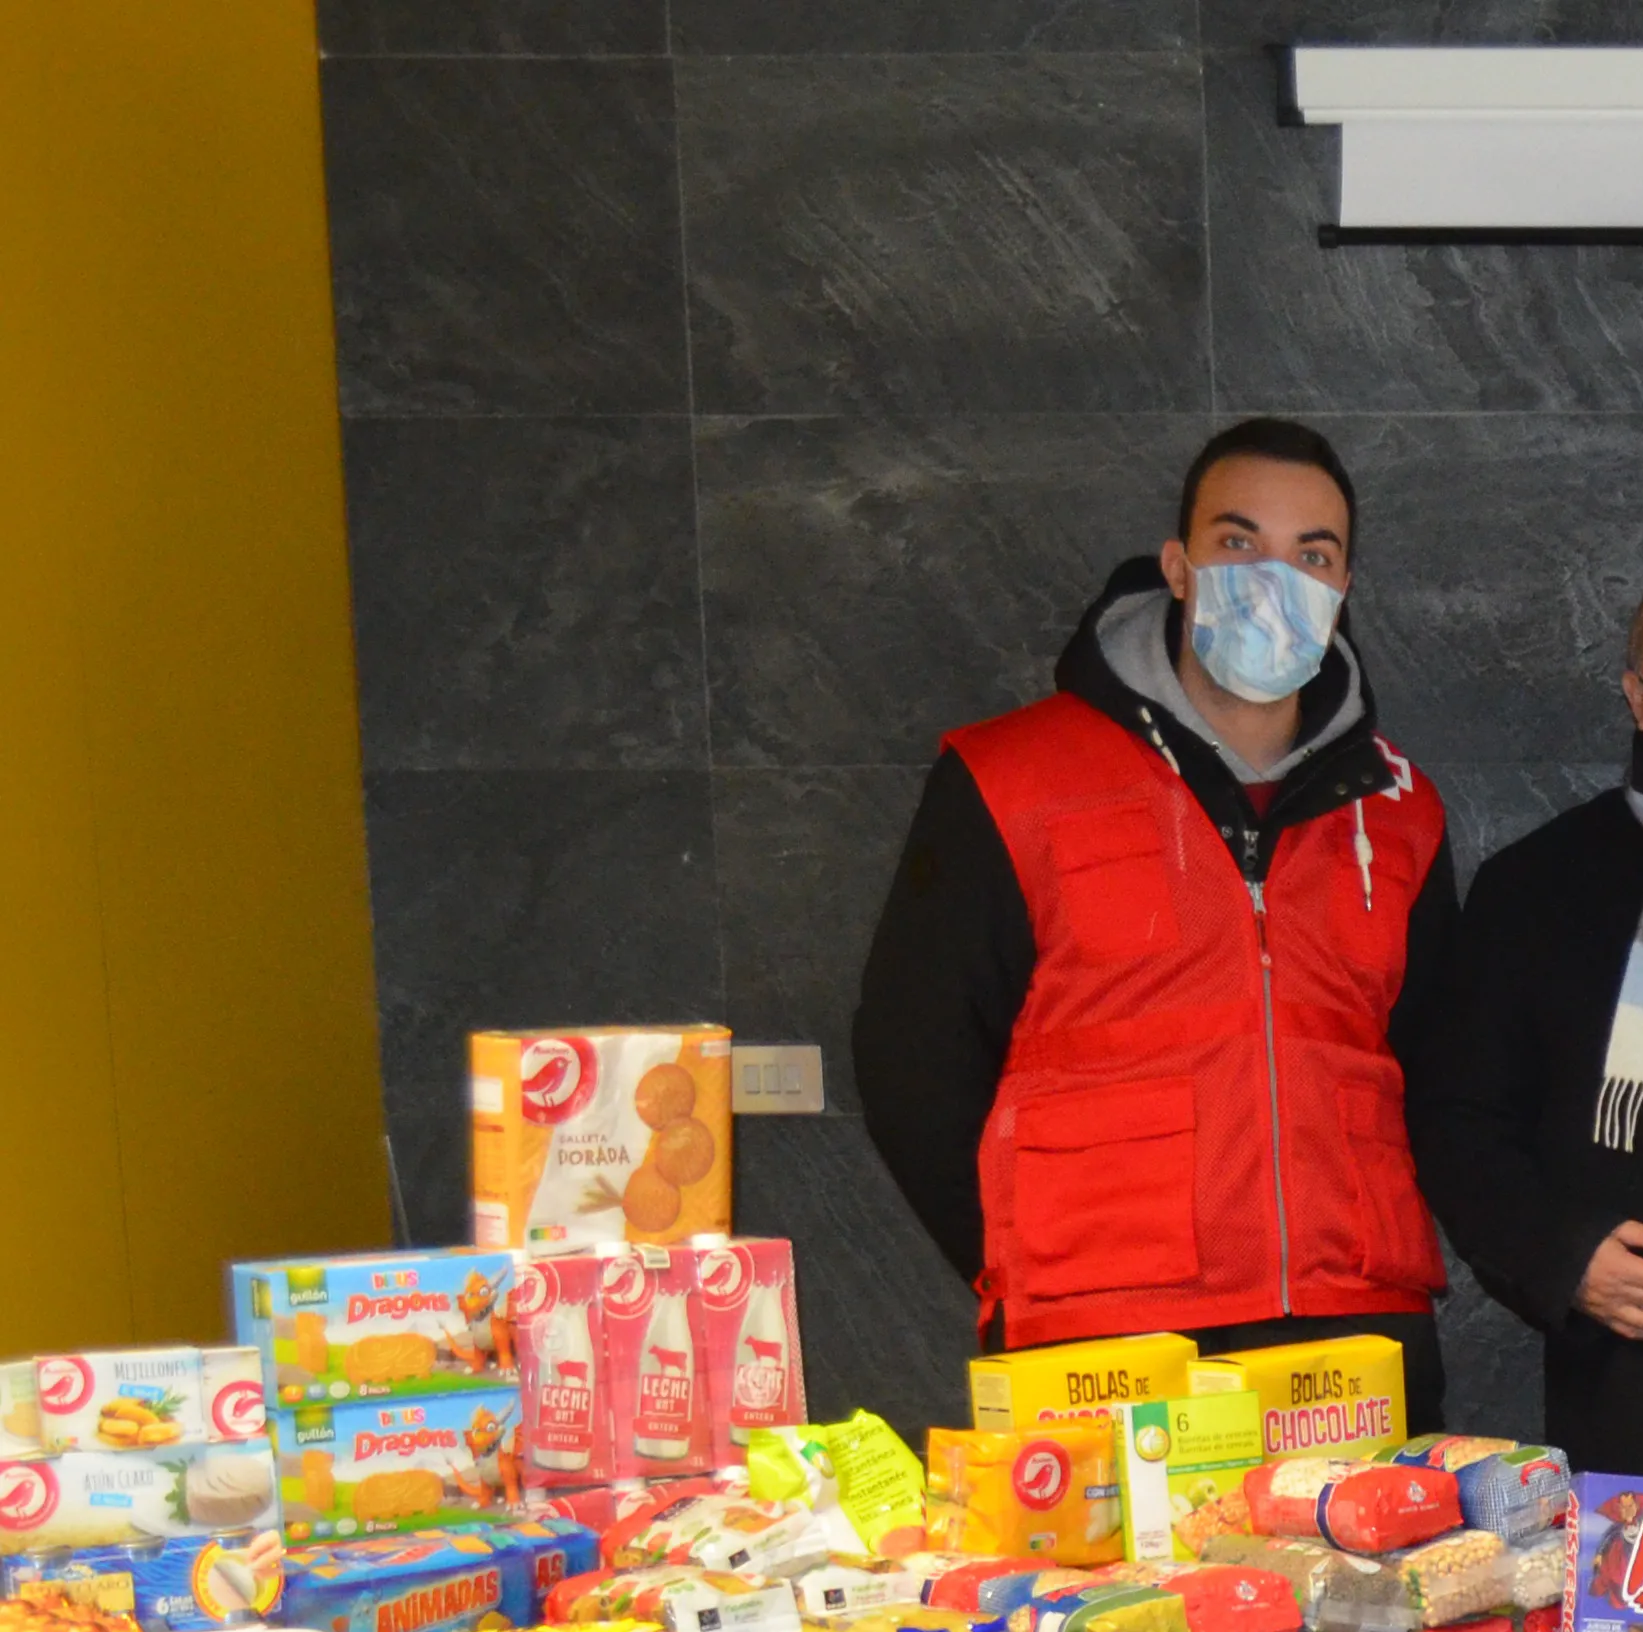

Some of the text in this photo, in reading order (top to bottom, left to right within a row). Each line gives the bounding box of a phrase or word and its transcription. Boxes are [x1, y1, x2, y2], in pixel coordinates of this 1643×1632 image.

[557, 1145, 631, 1167] DORADA
[289, 1290, 328, 1306] gullón
[346, 1290, 451, 1325] Dragons
[113, 1358, 188, 1382] MEJILLONES
[542, 1387, 590, 1411] LECHE
[642, 1377, 690, 1399] LECHE
[1067, 1370, 1150, 1405] BOLAS DE
[1290, 1369, 1362, 1406] BOLAS DE
[1176, 1412, 1190, 1433] 6
[1263, 1396, 1392, 1455] CHOCOLATE
[296, 1427, 334, 1444] gullón
[354, 1428, 458, 1462] Dragons
